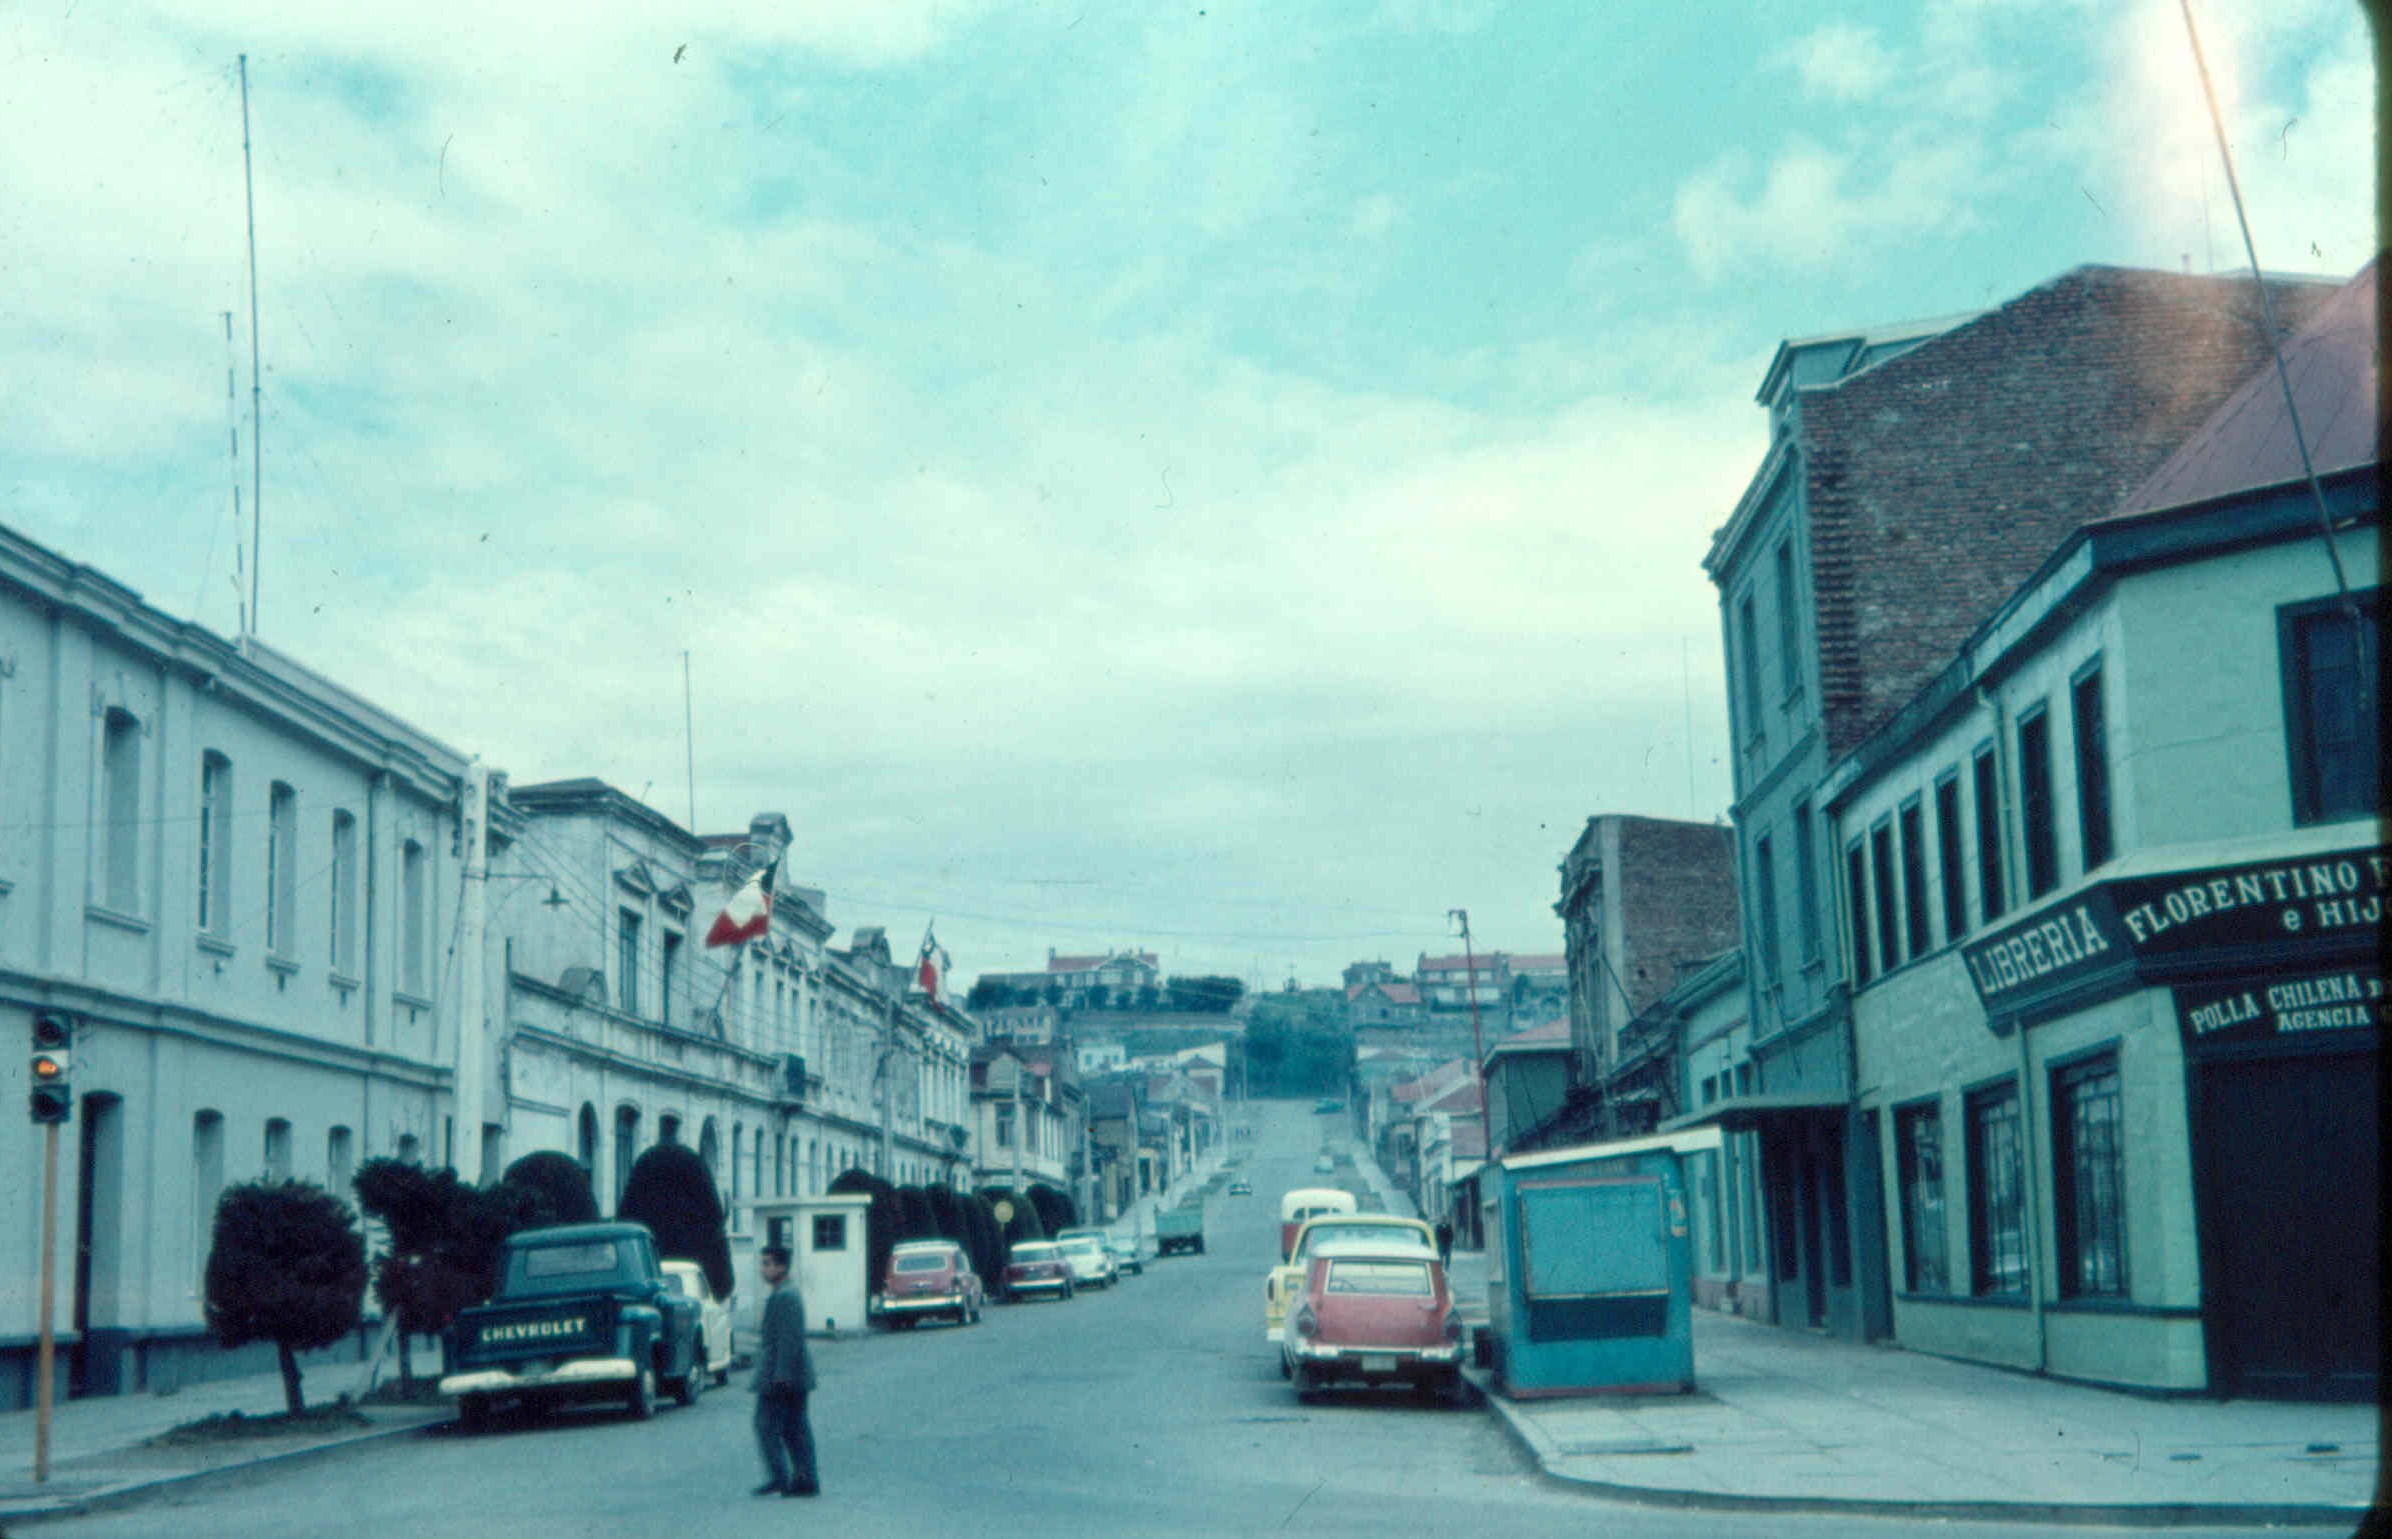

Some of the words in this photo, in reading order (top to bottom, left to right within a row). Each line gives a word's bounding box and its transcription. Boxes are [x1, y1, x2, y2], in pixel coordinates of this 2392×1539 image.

[2123, 860, 2360, 943] FLORENTINO
[2283, 909, 2301, 931] e
[1971, 905, 2109, 994] LIBRERIA
[2190, 992, 2260, 1034] POLLA
[2267, 973, 2362, 1011] CHILENA
[2277, 1004, 2371, 1032] AGENCIA
[482, 1317, 586, 1343] CHEVROLET
